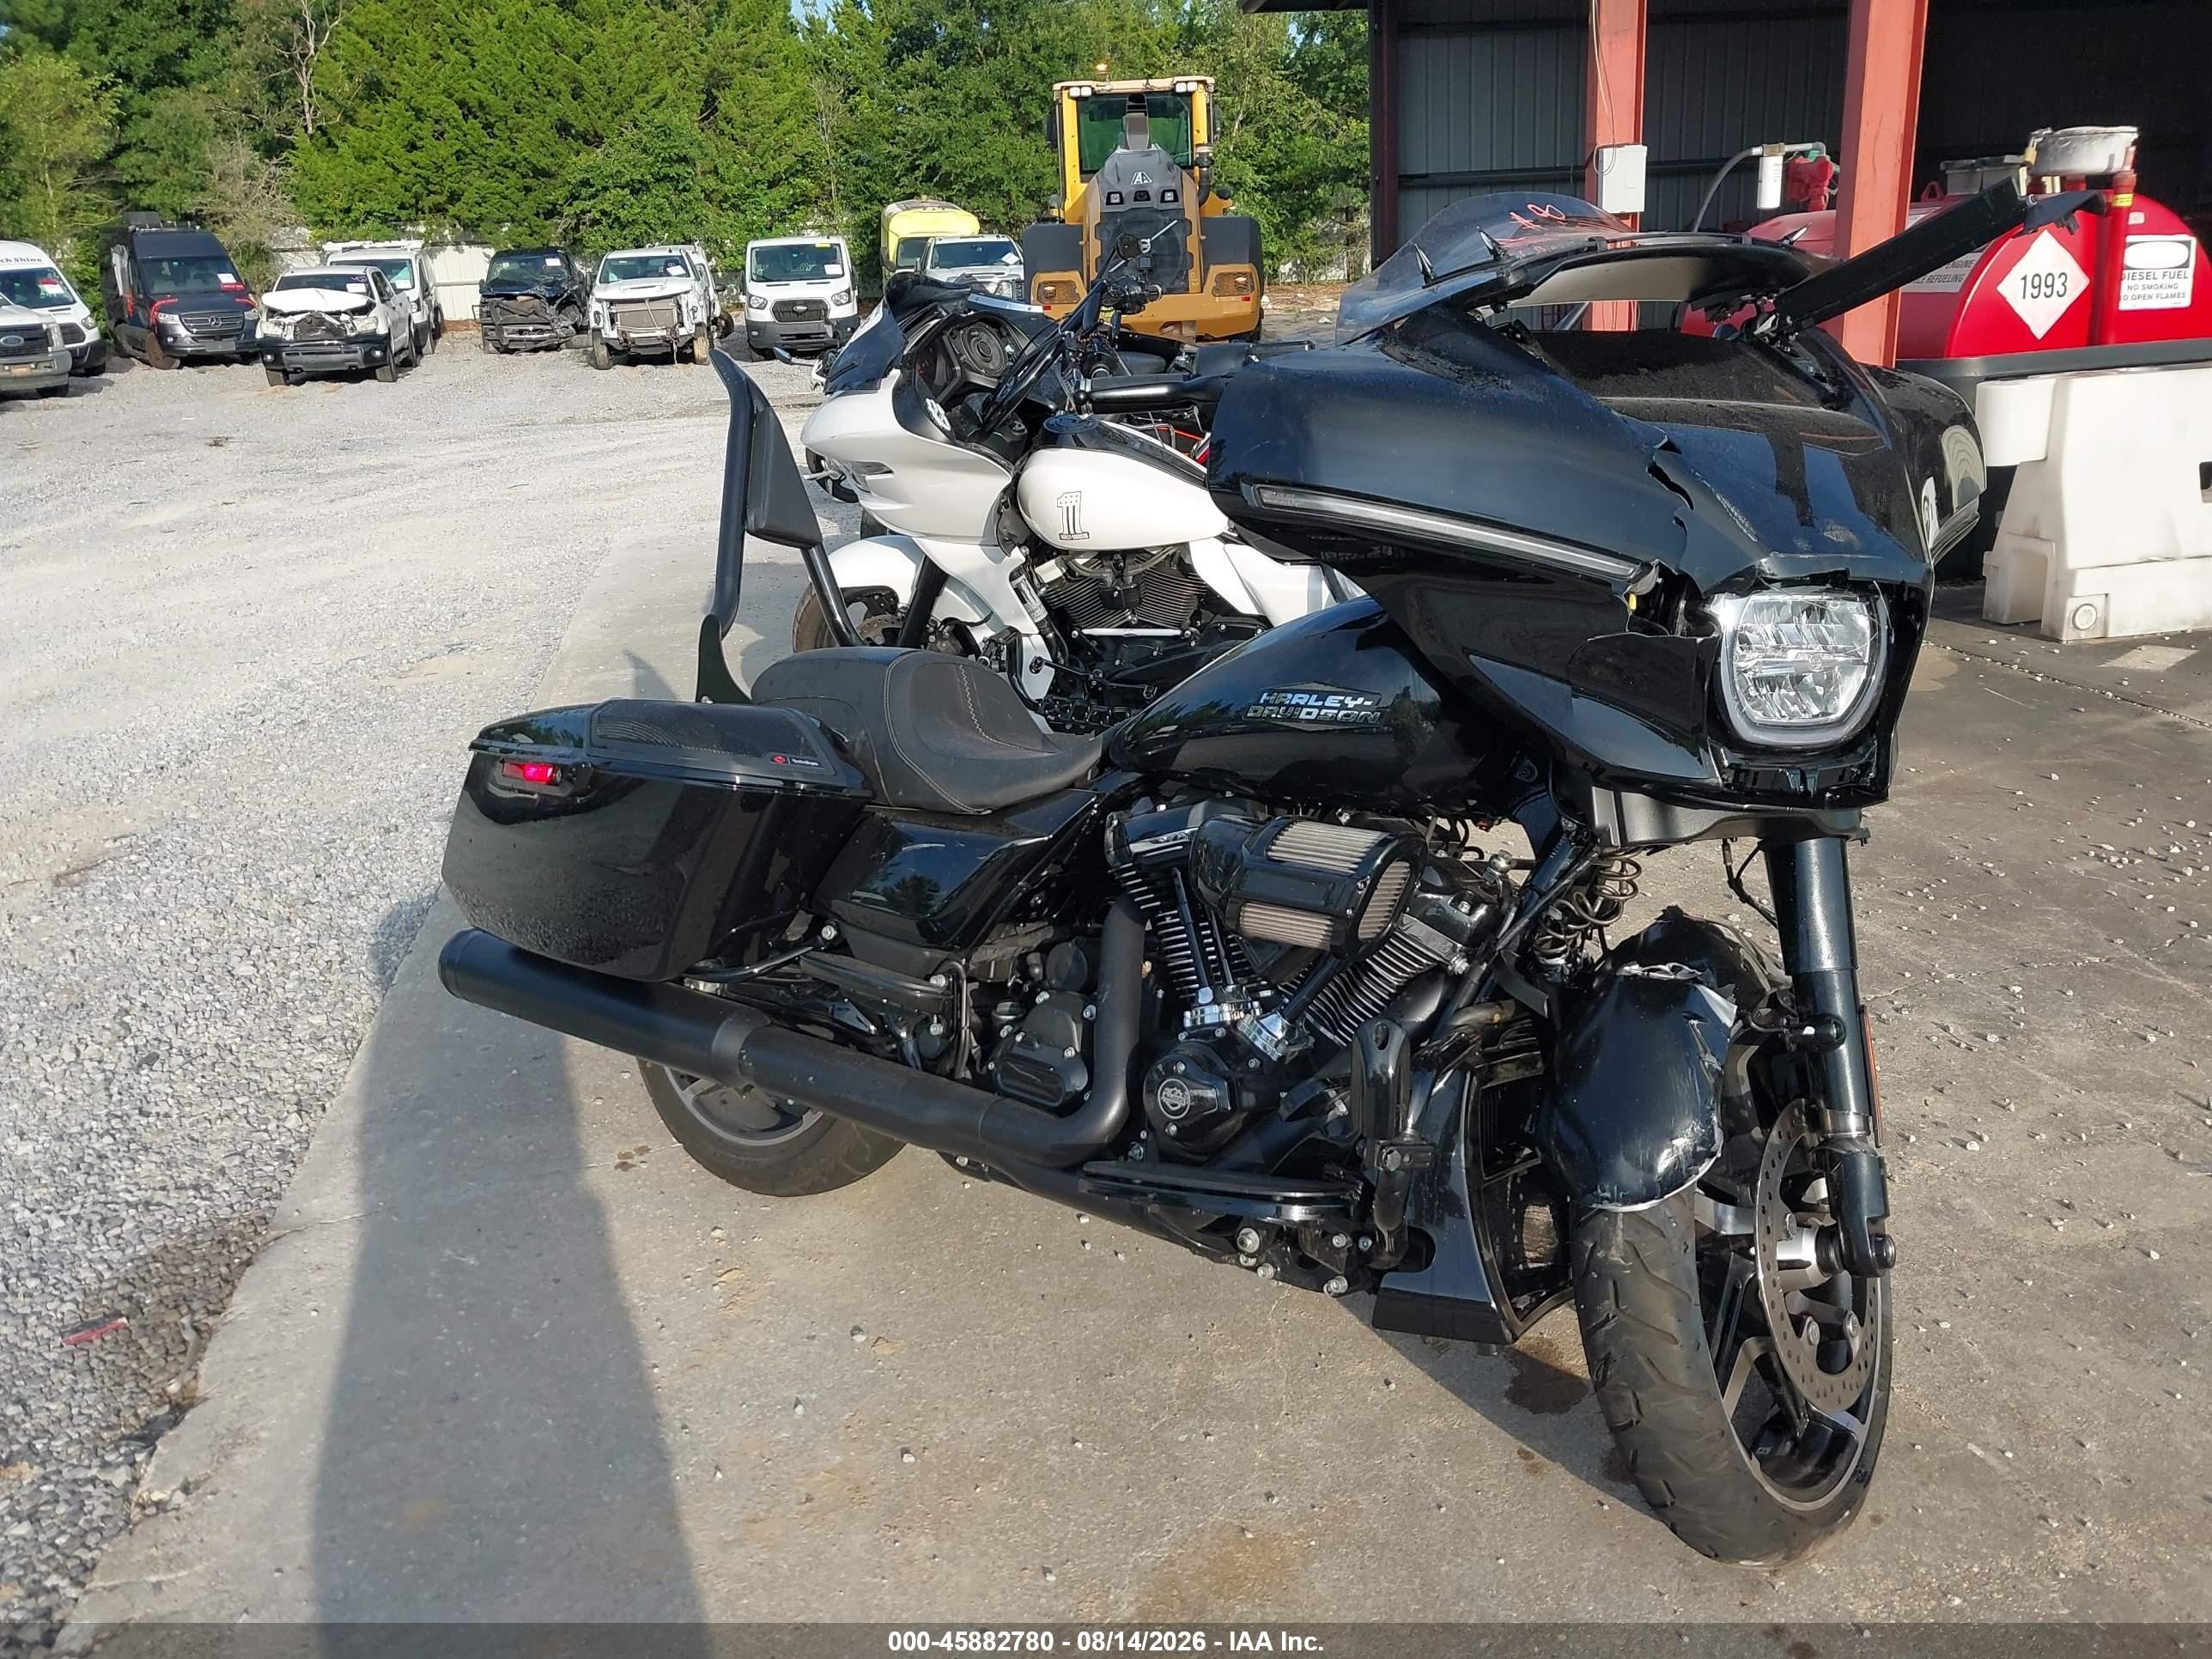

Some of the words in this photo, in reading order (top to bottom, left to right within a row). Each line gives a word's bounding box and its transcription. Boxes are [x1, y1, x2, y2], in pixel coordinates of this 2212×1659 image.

[2162, 270, 2189, 279] FUEL
[2021, 272, 2068, 300] 1993
[1259, 692, 1374, 708] HARLEY-
[1246, 705, 1382, 724] DAVIDSON
